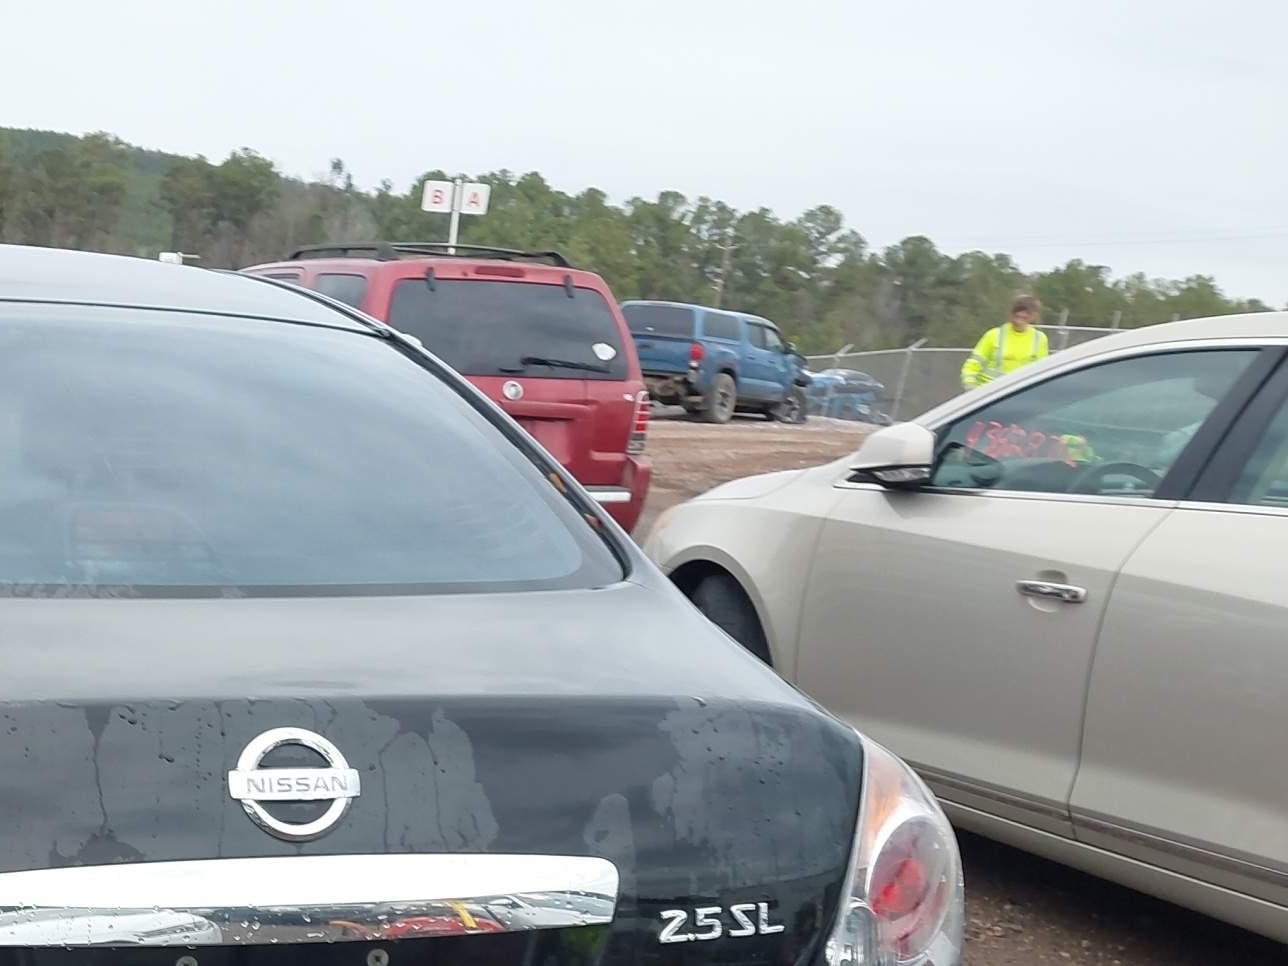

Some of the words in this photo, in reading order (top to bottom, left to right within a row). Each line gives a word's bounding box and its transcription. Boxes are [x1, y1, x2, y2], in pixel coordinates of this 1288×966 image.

[431, 188, 444, 205] B
[466, 190, 481, 208] A
[247, 774, 348, 793] NISSAN
